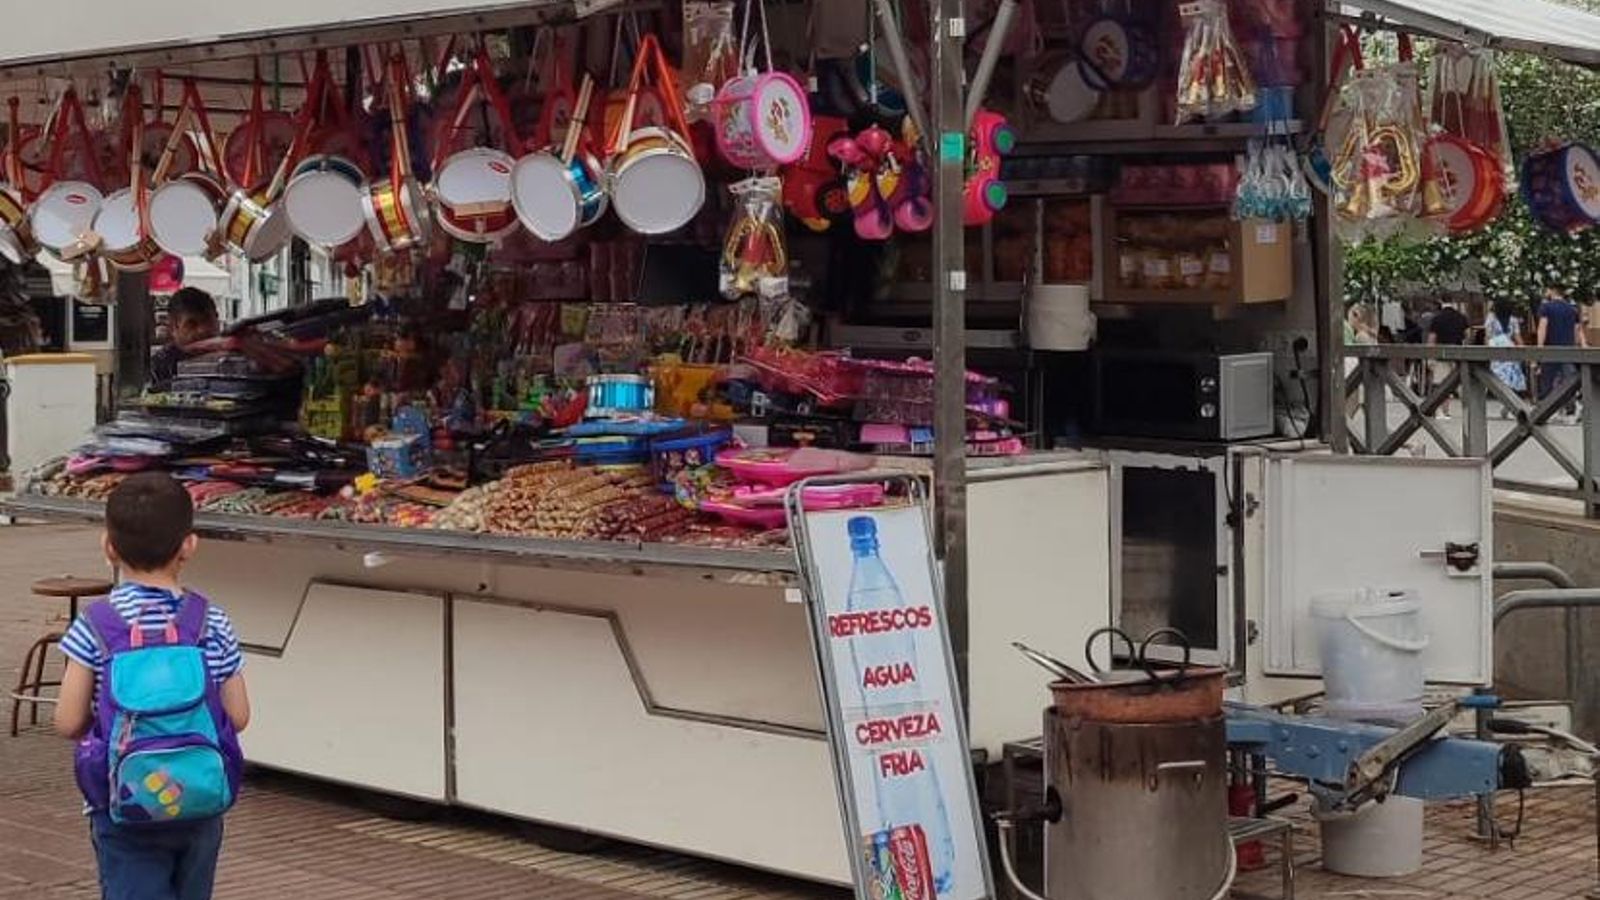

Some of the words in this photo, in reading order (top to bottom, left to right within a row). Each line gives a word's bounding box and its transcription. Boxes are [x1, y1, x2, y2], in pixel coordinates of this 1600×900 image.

[828, 606, 932, 638] REFRESCOS
[863, 662, 916, 688] AGUA
[856, 713, 941, 745] CERVEZA
[880, 750, 925, 777] FRIA
